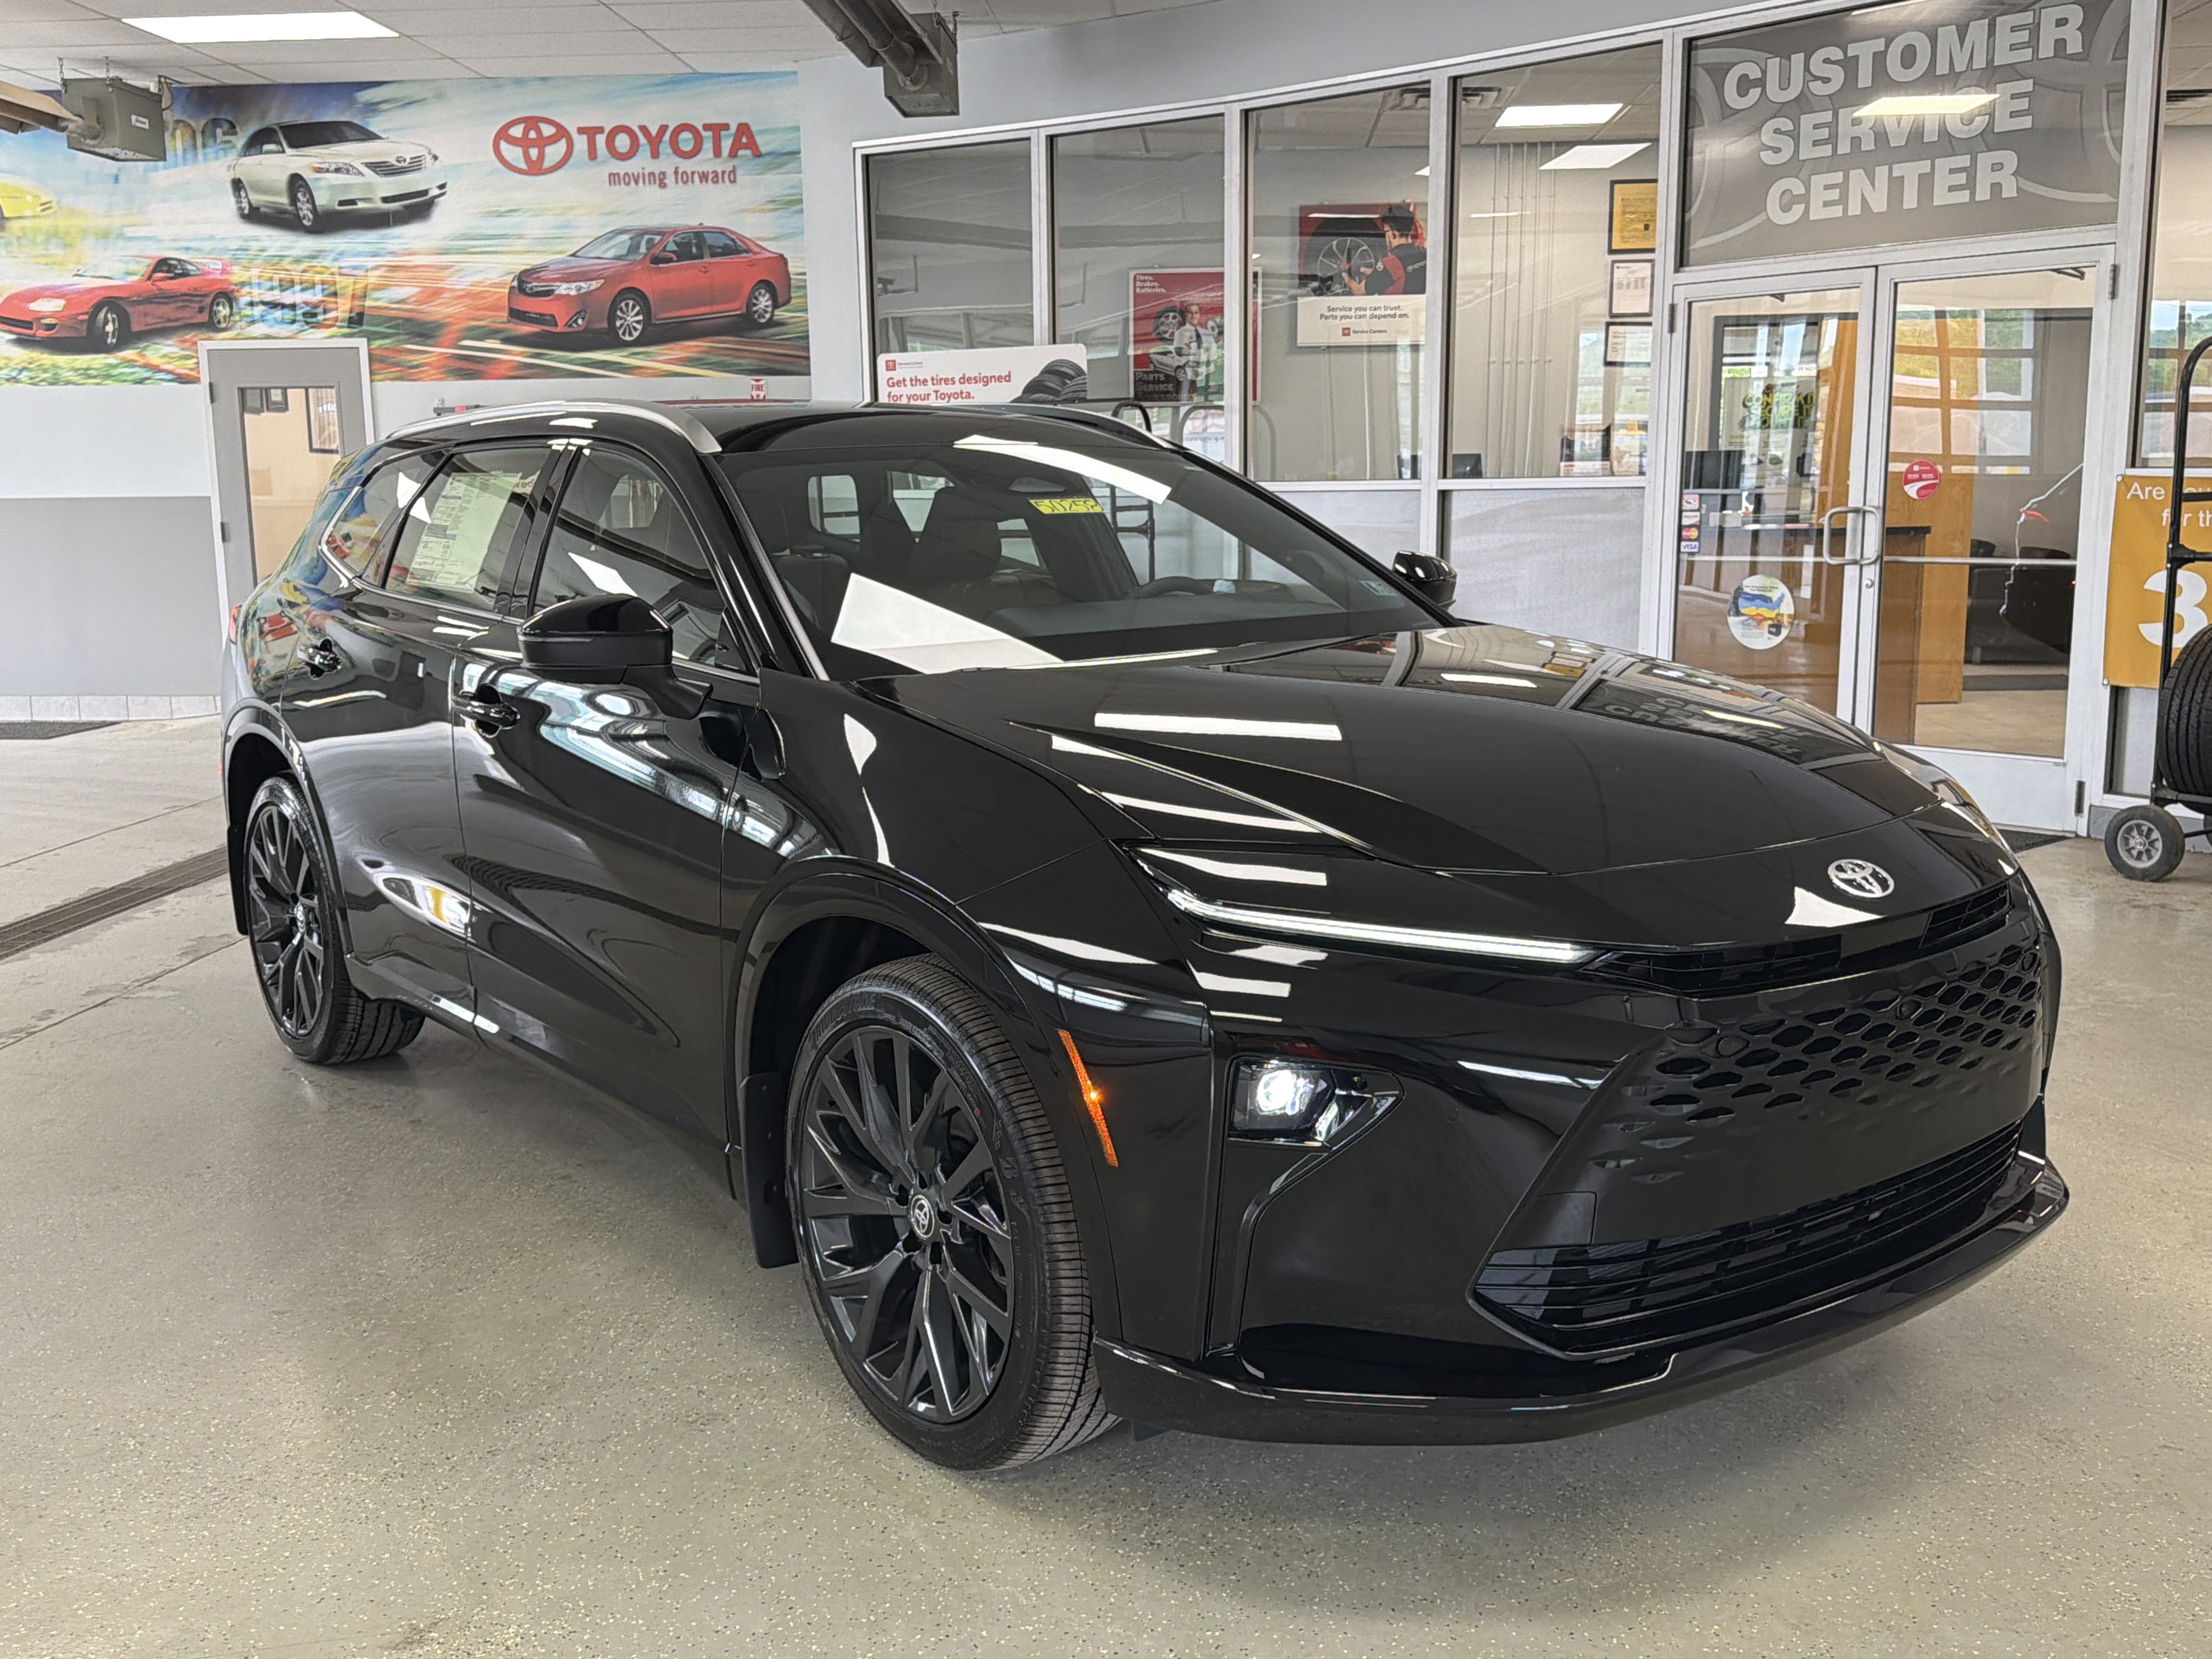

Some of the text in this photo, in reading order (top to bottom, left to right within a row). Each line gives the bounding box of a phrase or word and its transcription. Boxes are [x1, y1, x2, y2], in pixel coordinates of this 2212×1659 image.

[1723, 4, 2084, 110] CUSTOMER
[1759, 79, 2034, 166] SERVICE
[577, 122, 761, 161] TOYOTA
[608, 165, 737, 188] moving forward
[1765, 150, 2019, 225] CENTER
[887, 371, 1011, 388] Get the tires designed
[1136, 372, 1165, 381] PARTS
[1136, 382, 1175, 392] SERVICE
[887, 390, 974, 404] for your Toyota.
[2126, 482, 2165, 500] Are
[2162, 508, 2192, 527] fr
[2138, 569, 2208, 648] 3
